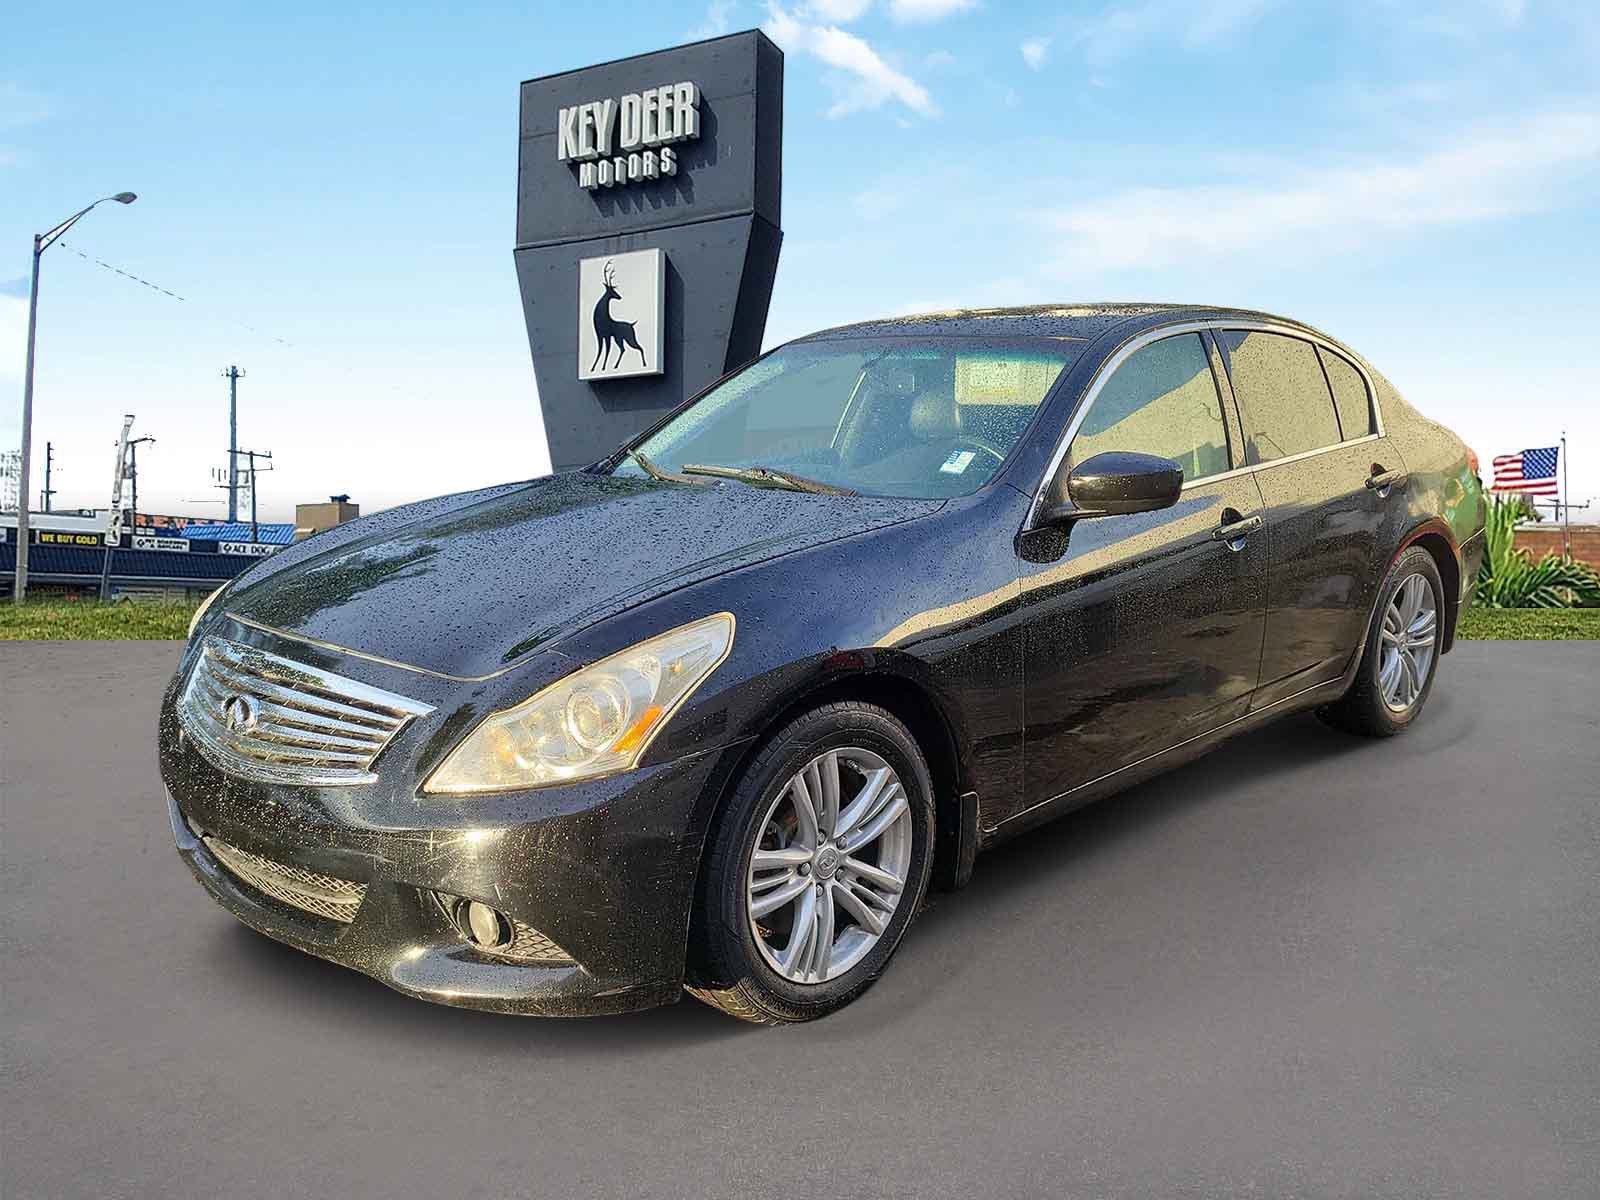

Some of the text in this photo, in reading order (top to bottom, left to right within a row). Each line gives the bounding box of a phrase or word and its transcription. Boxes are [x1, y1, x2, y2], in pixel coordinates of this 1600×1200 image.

[558, 81, 701, 161] KEY DEER
[578, 147, 678, 191] MOTORS
[41, 533, 97, 545] WE BUY GOLD
[251, 546, 270, 555] DOG
